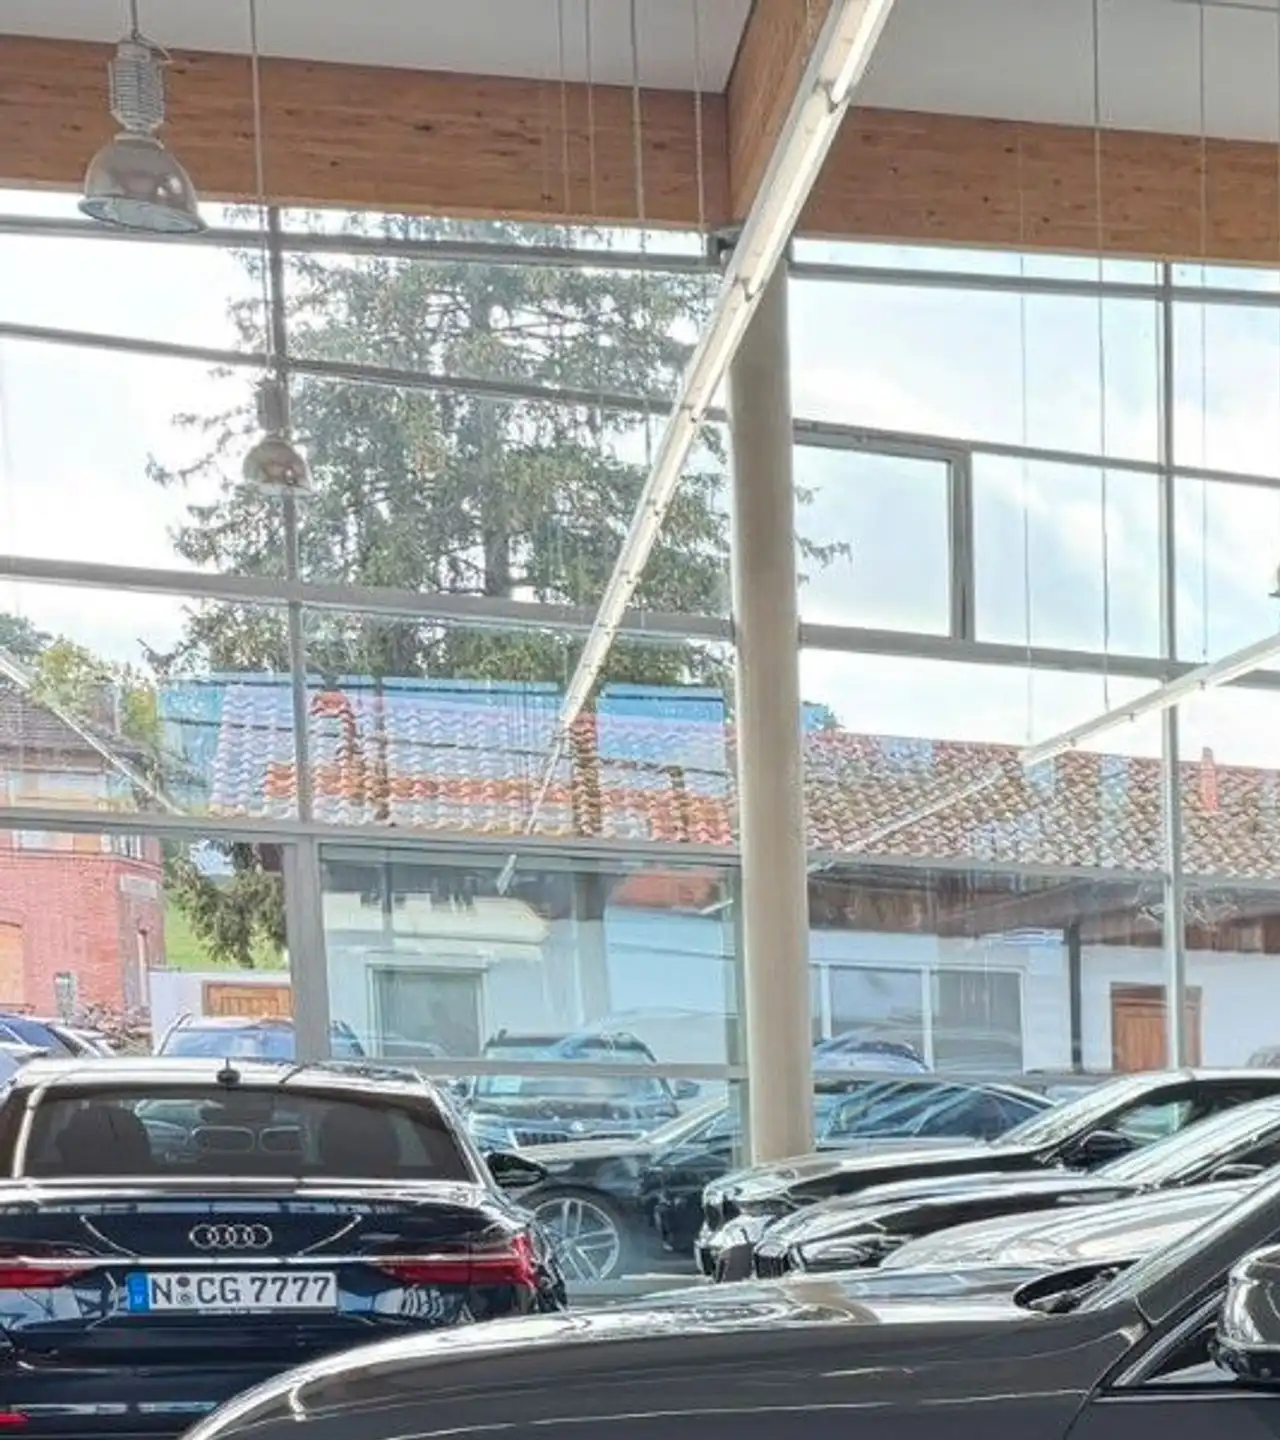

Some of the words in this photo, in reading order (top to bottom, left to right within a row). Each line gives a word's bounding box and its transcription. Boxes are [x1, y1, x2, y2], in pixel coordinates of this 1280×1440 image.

[152, 1277, 172, 1305] N
[196, 1276, 240, 1304] CG
[250, 1276, 331, 1303] 7777
